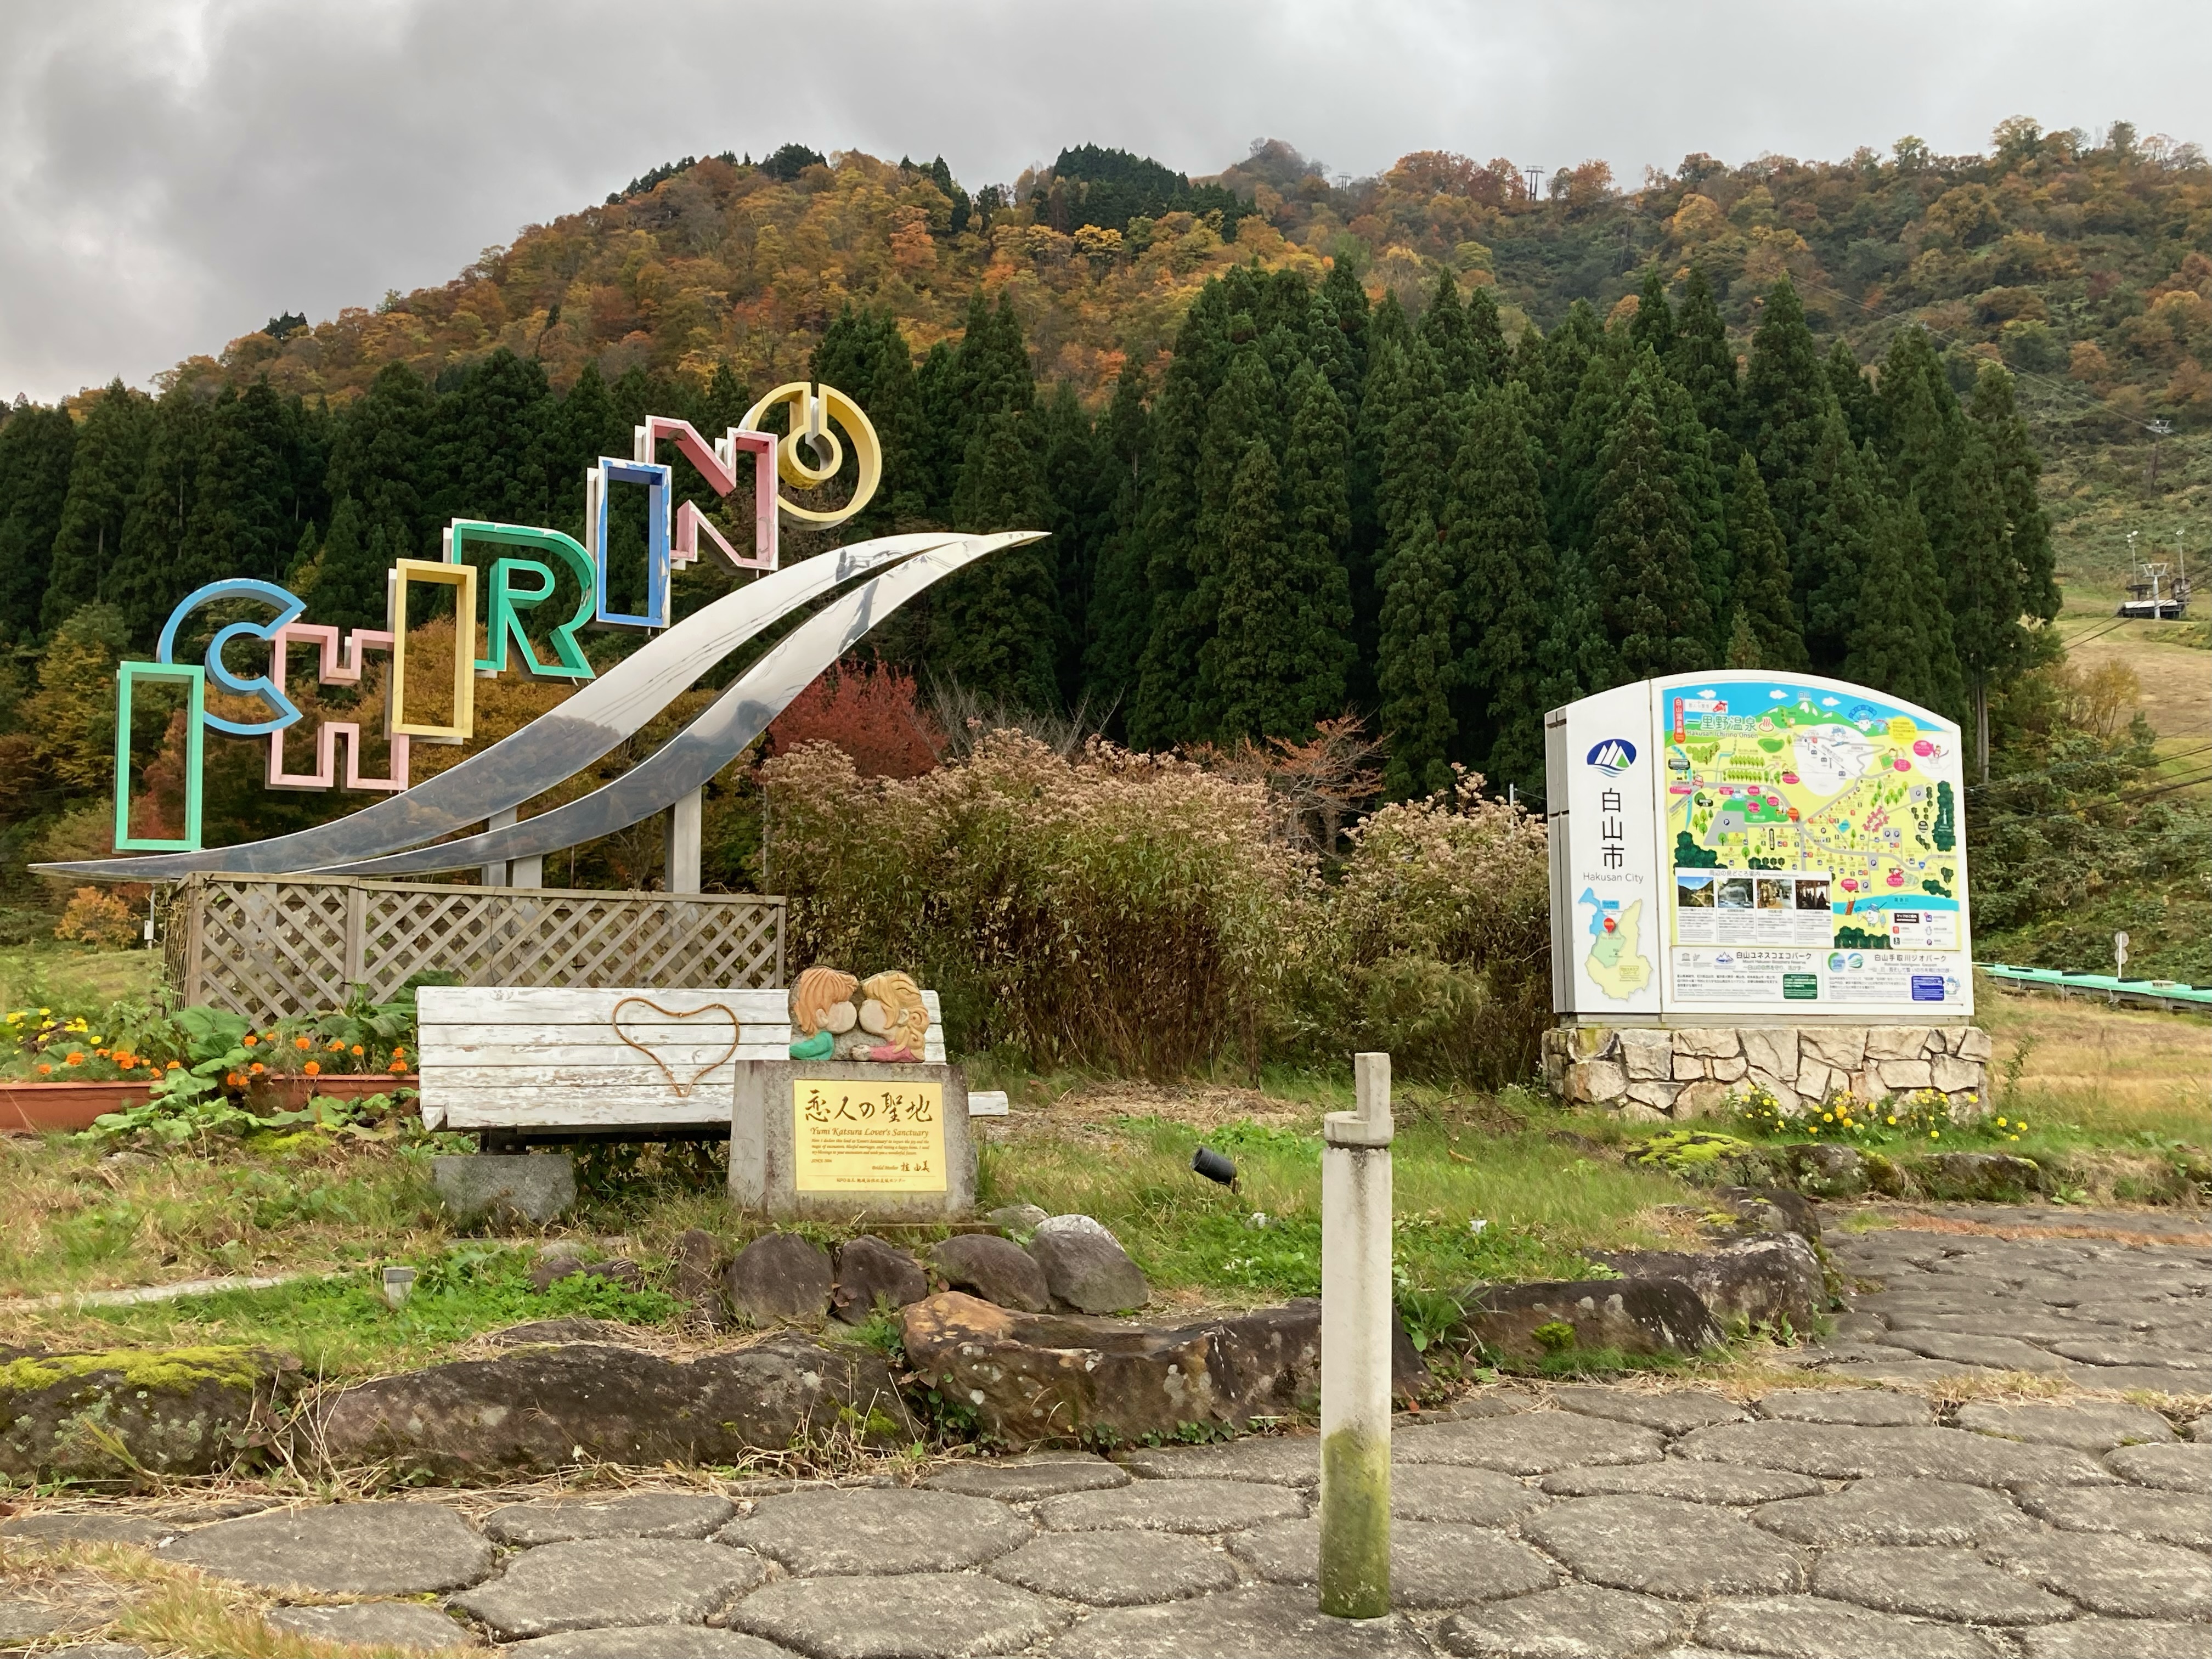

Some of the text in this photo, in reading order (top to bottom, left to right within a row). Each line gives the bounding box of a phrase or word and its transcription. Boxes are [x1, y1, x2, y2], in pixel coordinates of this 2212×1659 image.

[114, 381, 882, 853] ICHIRINO
[1686, 716, 1757, 731] 一里野温泉
[1601, 787, 1624, 870] 白山市
[1583, 872, 1644, 884] Hakusan City
[805, 1088, 933, 1123] 恋人の聖地
[810, 1127, 831, 1135] Yumi
[832, 1127, 862, 1136] Katsura
[891, 1128, 929, 1138] Sanctuary
